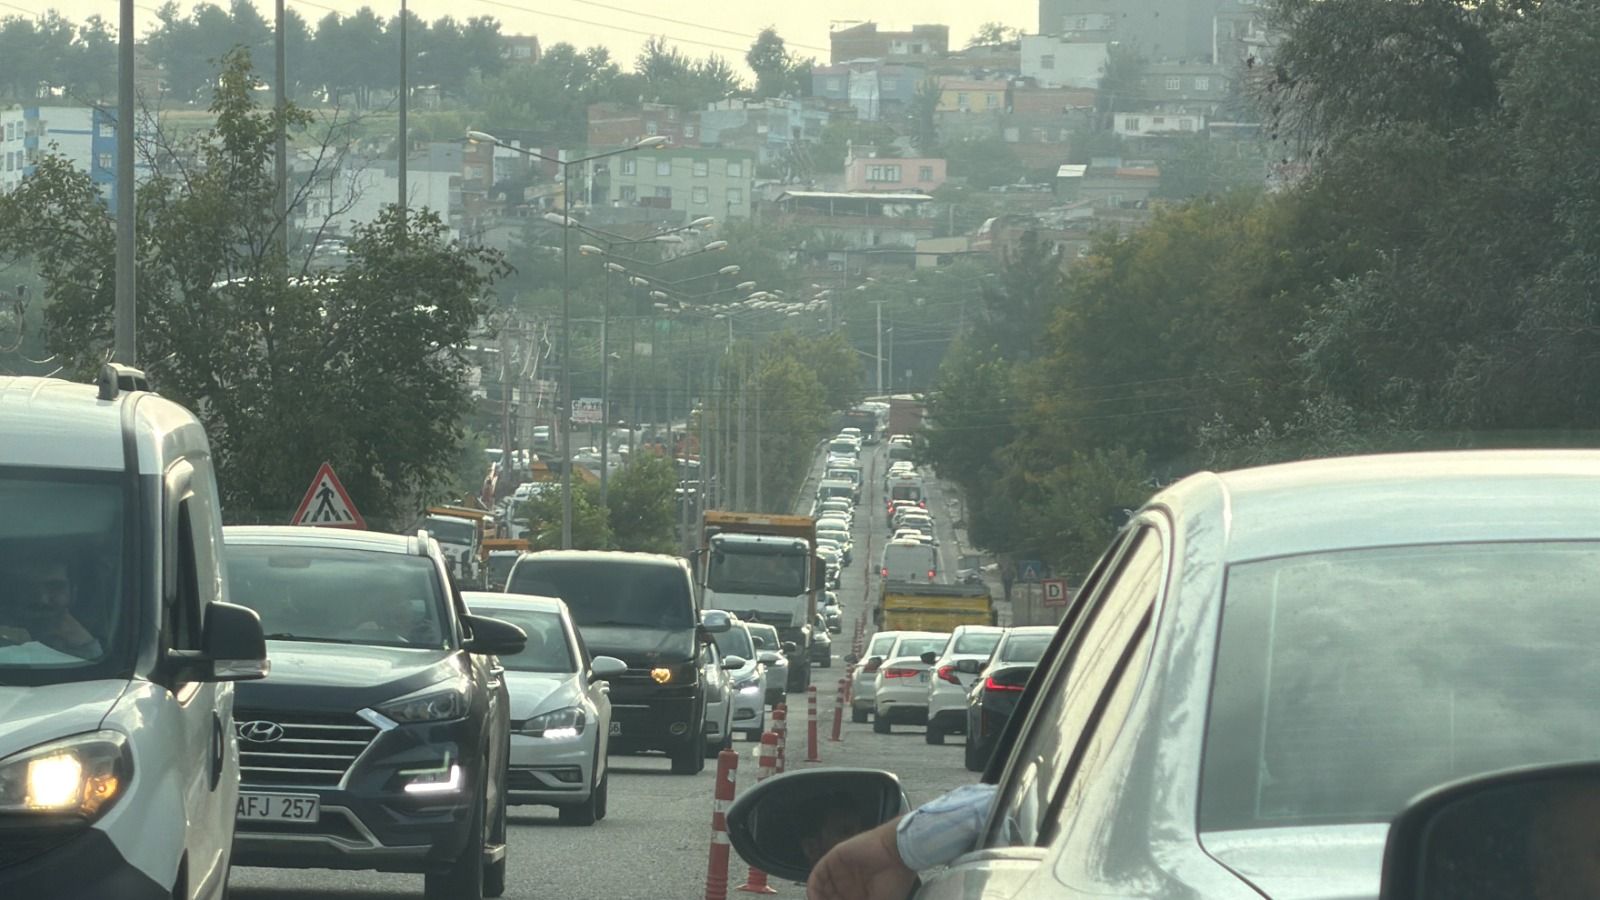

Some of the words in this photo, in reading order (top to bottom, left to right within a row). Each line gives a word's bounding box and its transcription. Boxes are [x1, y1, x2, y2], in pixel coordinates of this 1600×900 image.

[1049, 584, 1060, 597] D
[237, 796, 270, 817] AFJ
[281, 798, 316, 819] 257
